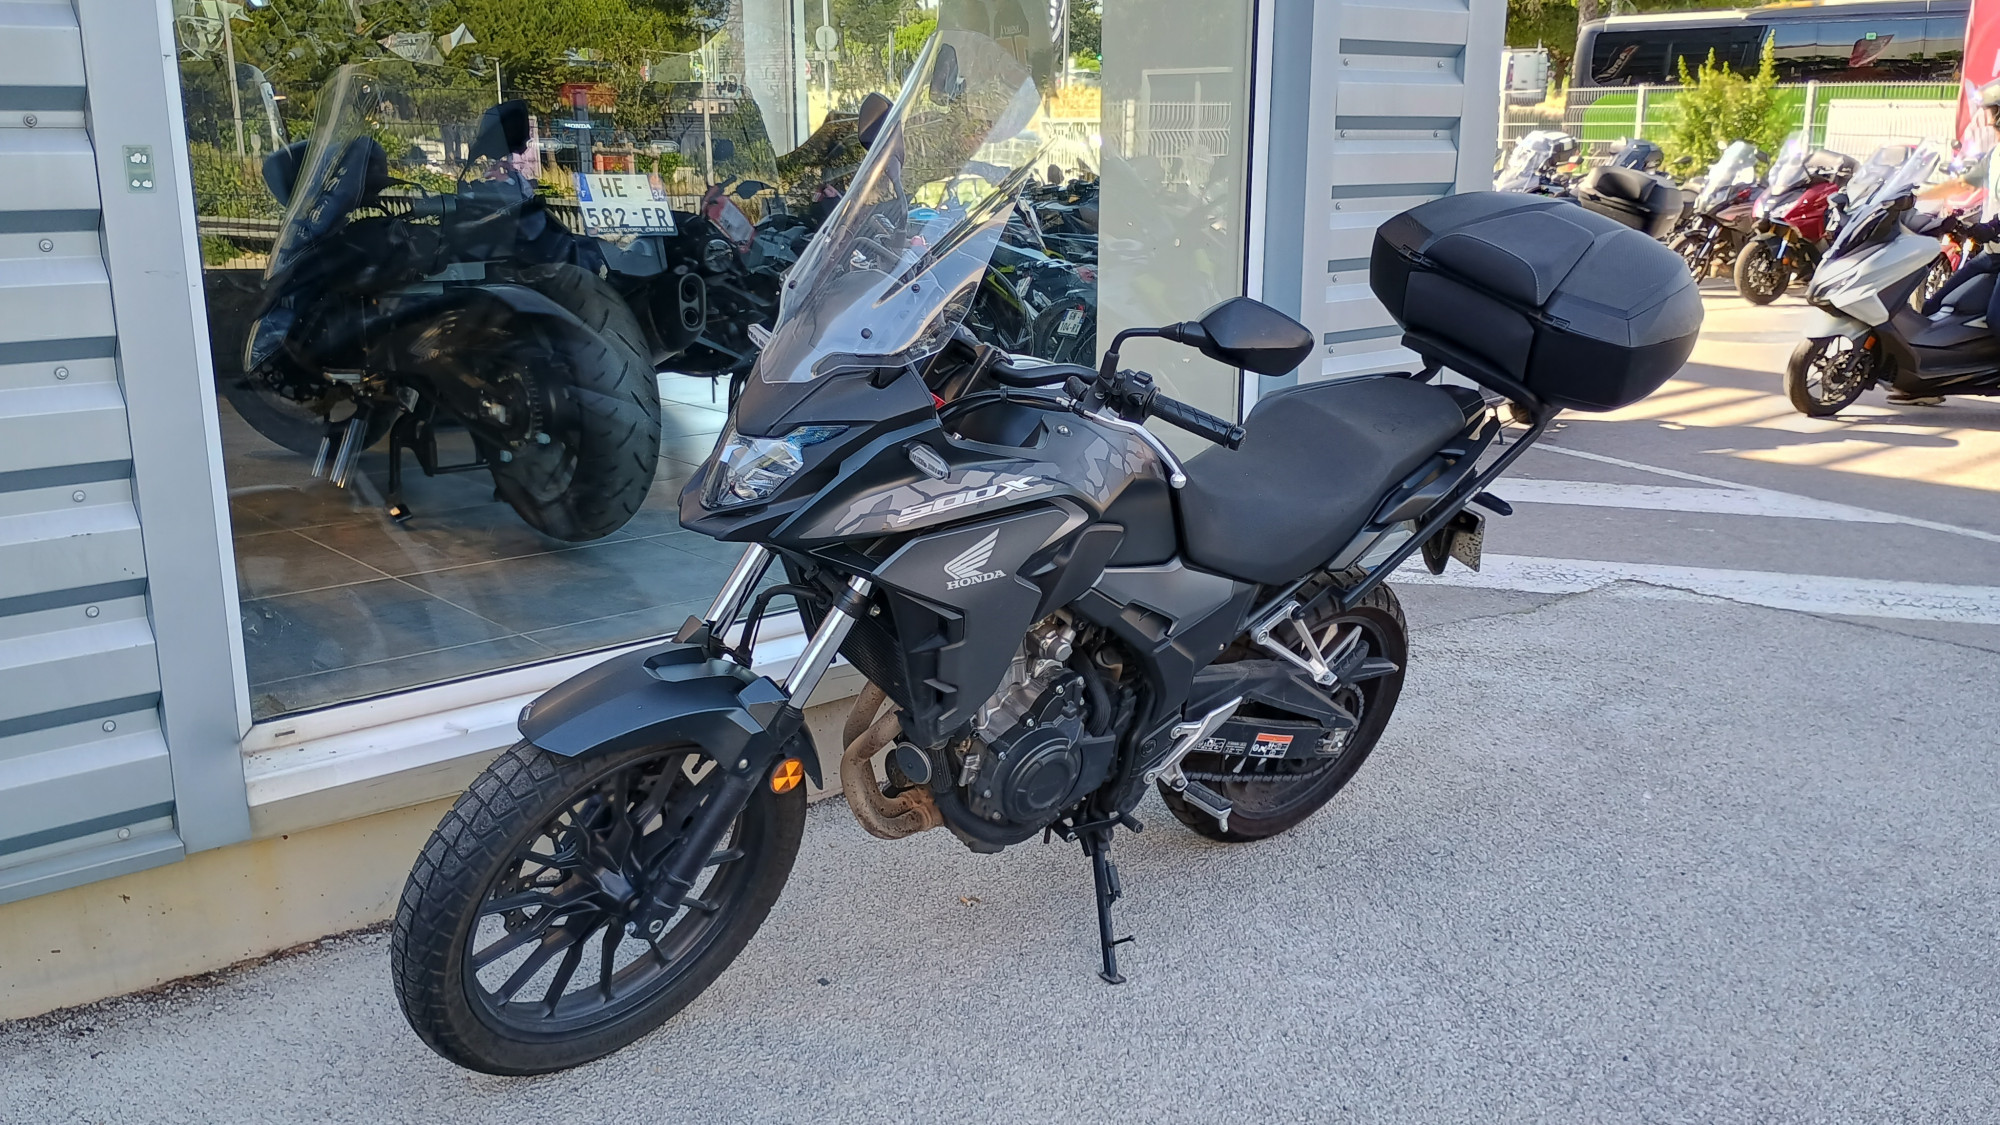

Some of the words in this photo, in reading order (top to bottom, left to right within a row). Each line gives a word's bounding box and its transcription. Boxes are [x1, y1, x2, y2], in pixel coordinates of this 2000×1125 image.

[652, 189, 665, 200] 34
[897, 475, 1034, 524] 500X
[946, 569, 1007, 591] HONDA
